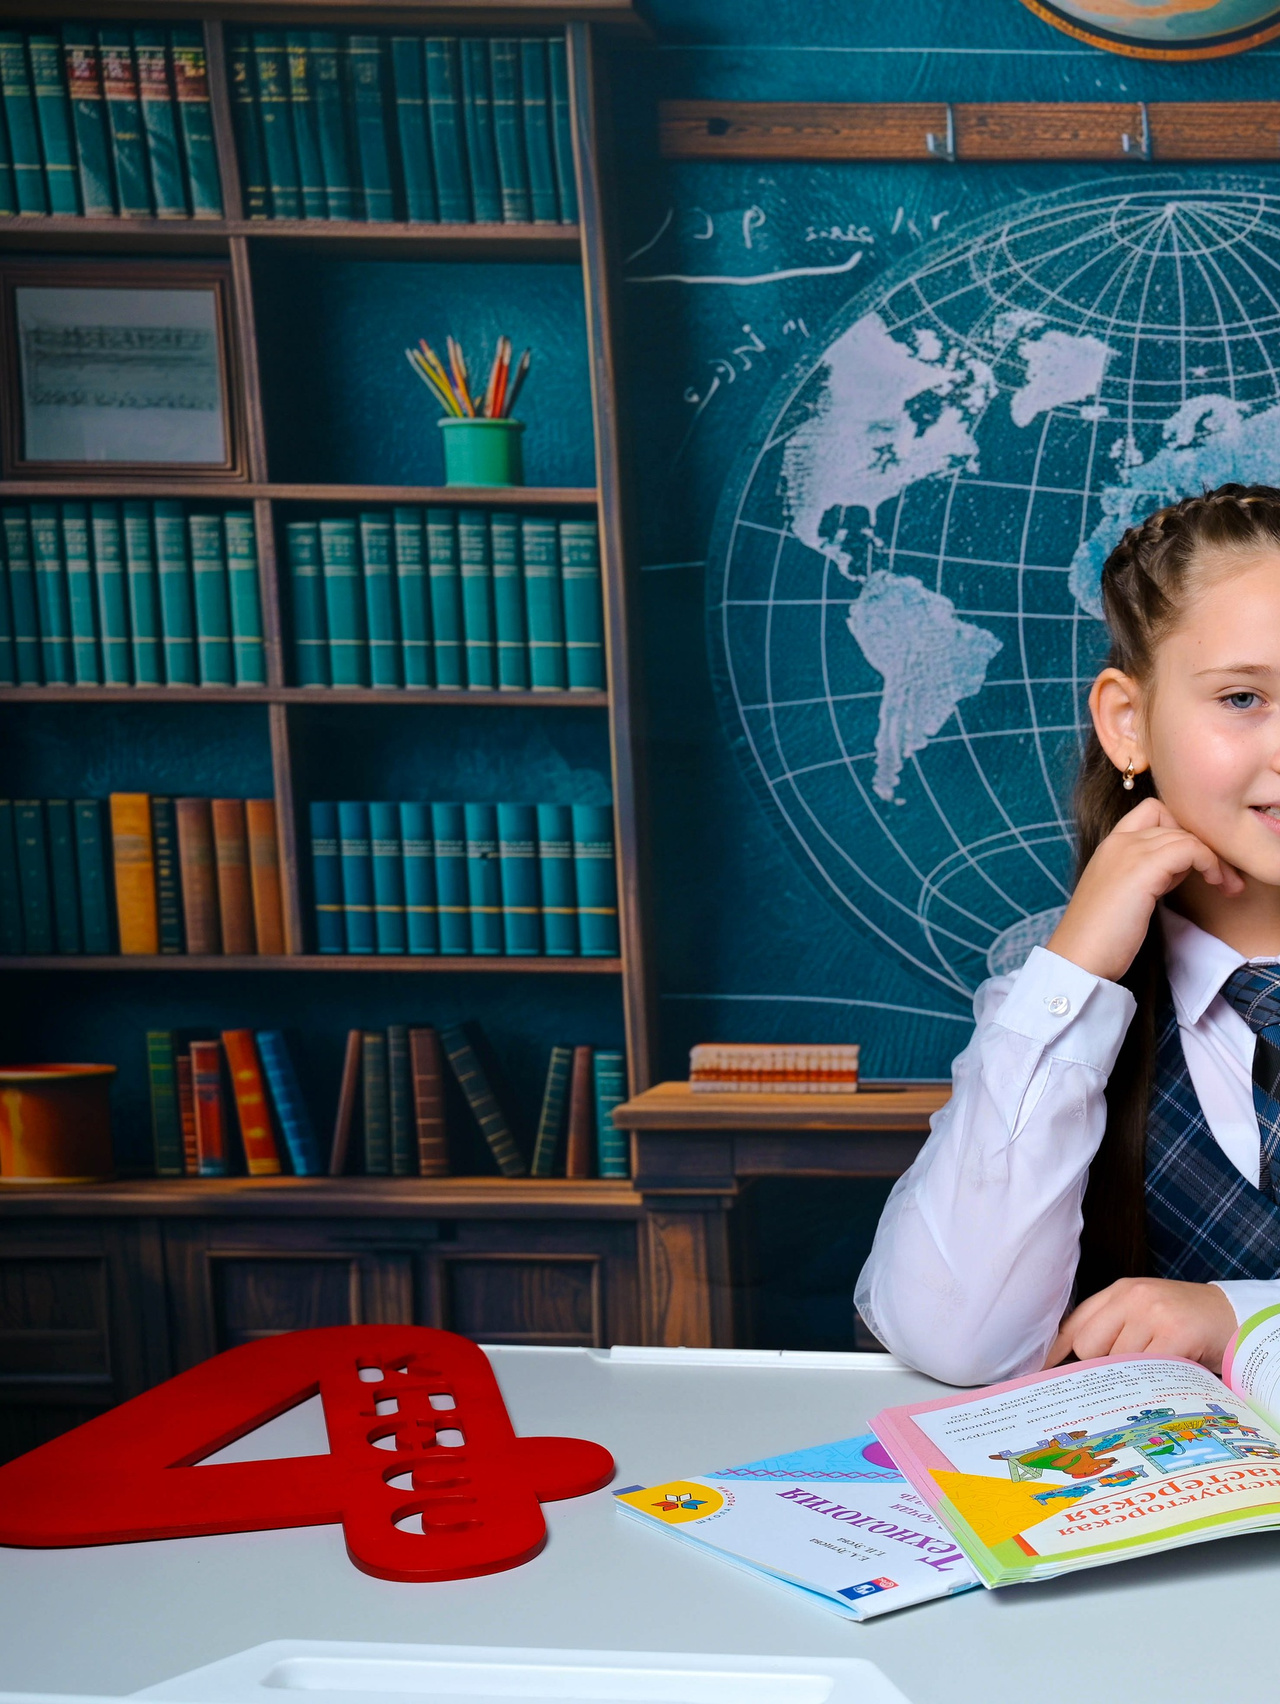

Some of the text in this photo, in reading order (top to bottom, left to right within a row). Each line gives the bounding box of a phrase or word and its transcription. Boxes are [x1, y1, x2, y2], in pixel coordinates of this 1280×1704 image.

[1000, 1386, 1063, 1407] технологи
[1026, 1387, 1115, 1415] неподвижного
[945, 1414, 1018, 1435] соединения
[1027, 1409, 1068, 1424] детали
[1042, 1399, 1167, 1434] мастером-бобром
[954, 1425, 1016, 1444] конструк-
[695, 1508, 731, 1525] ШКОЛА
[888, 1503, 943, 1531] бочая
[775, 1487, 965, 1572] Технология
